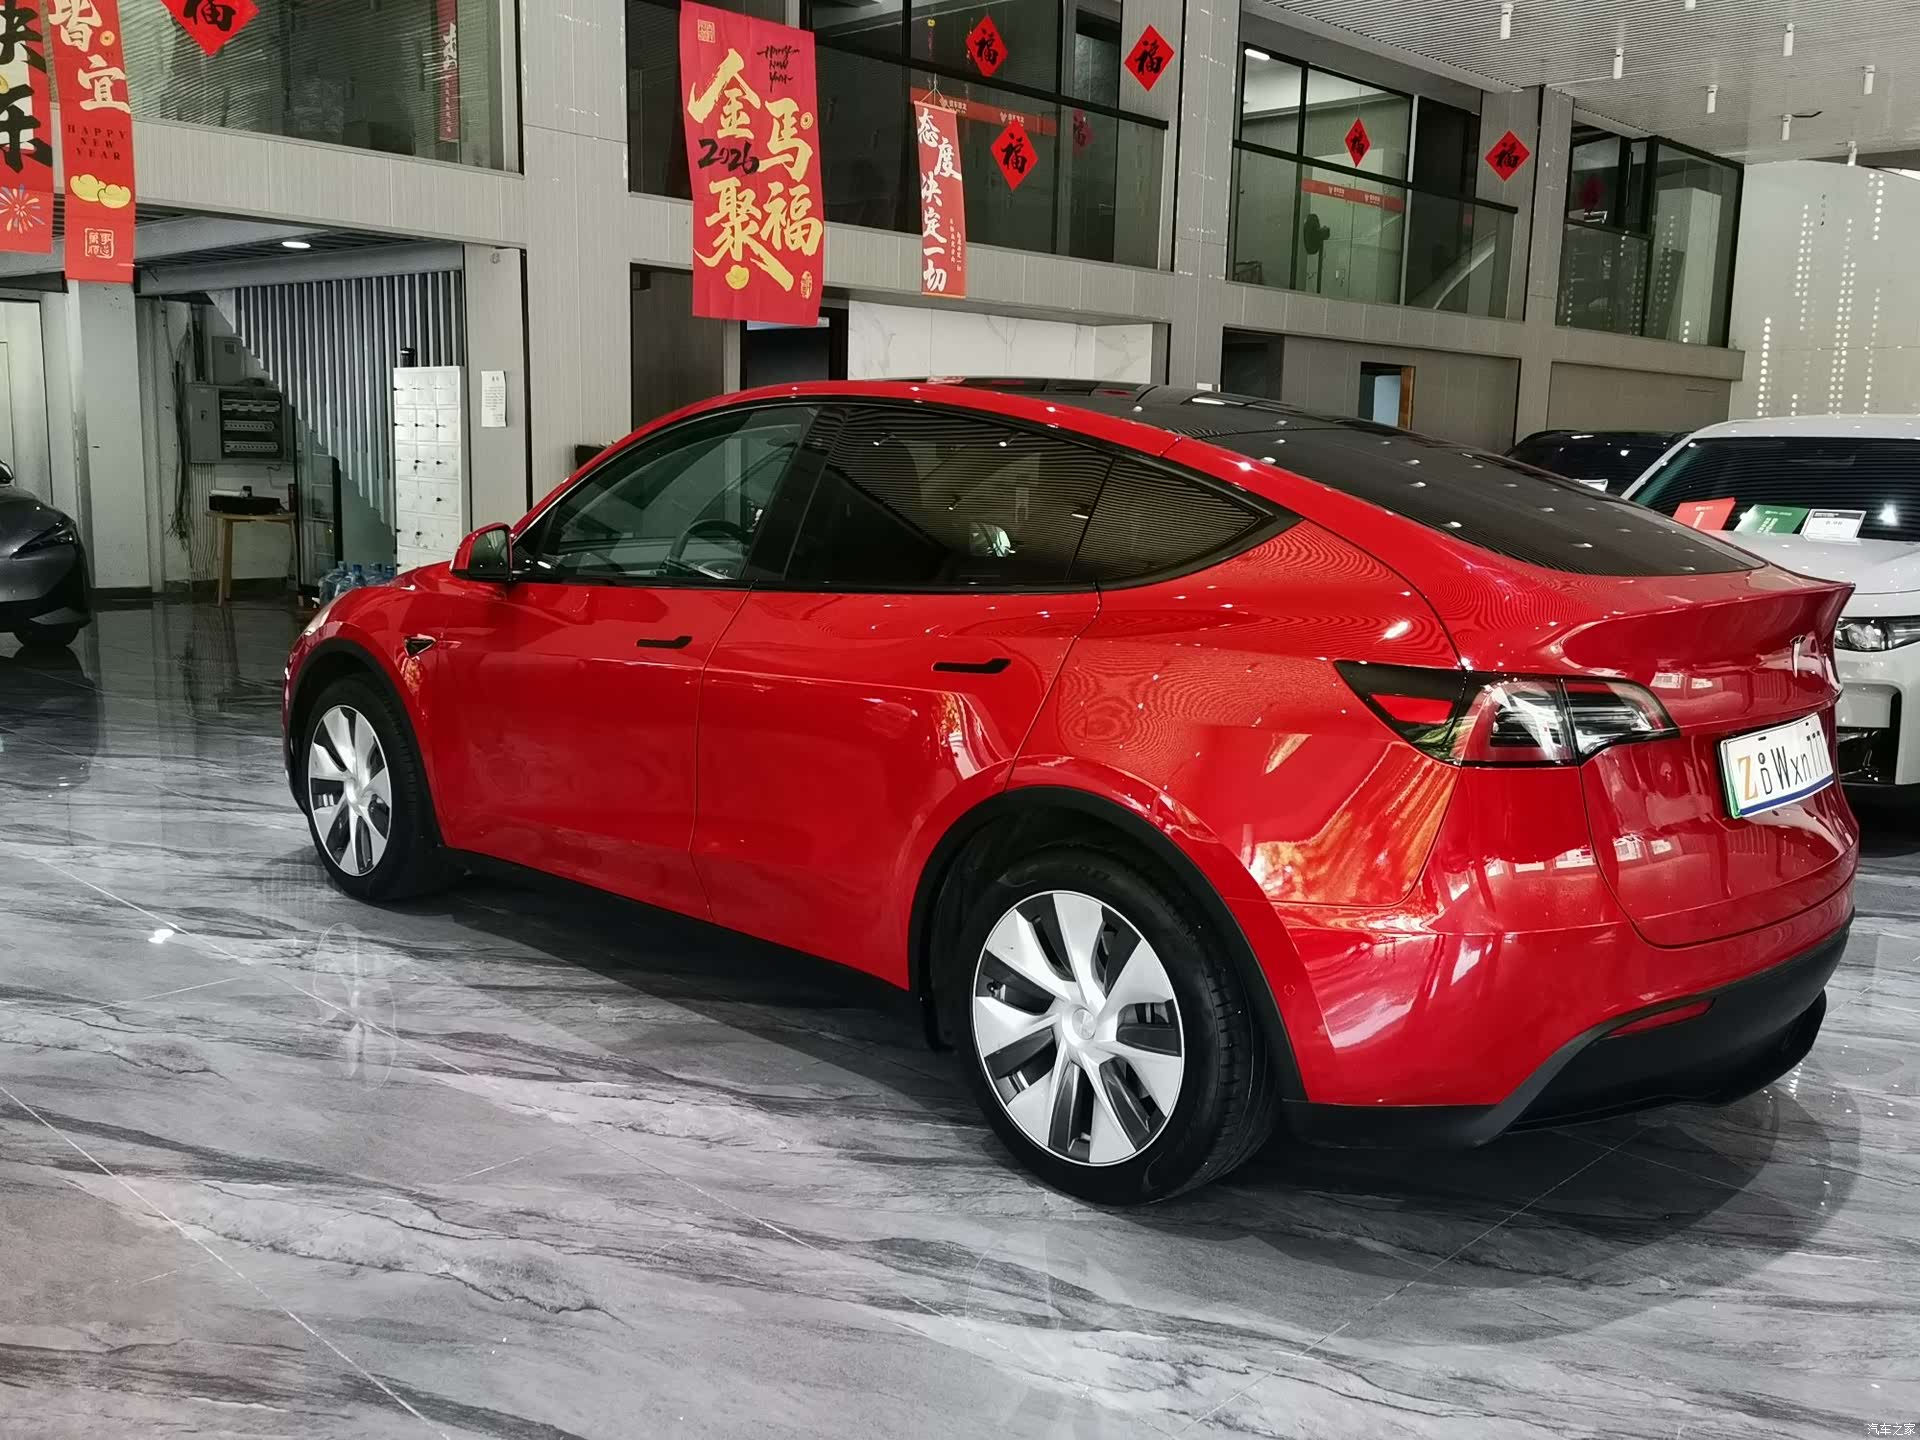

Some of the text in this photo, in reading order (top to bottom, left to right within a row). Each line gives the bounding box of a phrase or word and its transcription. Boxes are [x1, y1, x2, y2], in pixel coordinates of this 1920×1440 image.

[975, 28, 999, 66] 福
[1135, 40, 1163, 75] 福
[67, 124, 127, 140] HAPPY
[80, 136, 114, 149] NEW
[76, 147, 121, 161] YEAR
[697, 138, 760, 175] 2026
[1002, 132, 1028, 174] 福
[1494, 142, 1520, 169] 福
[917, 107, 963, 291] 态度决定一切
